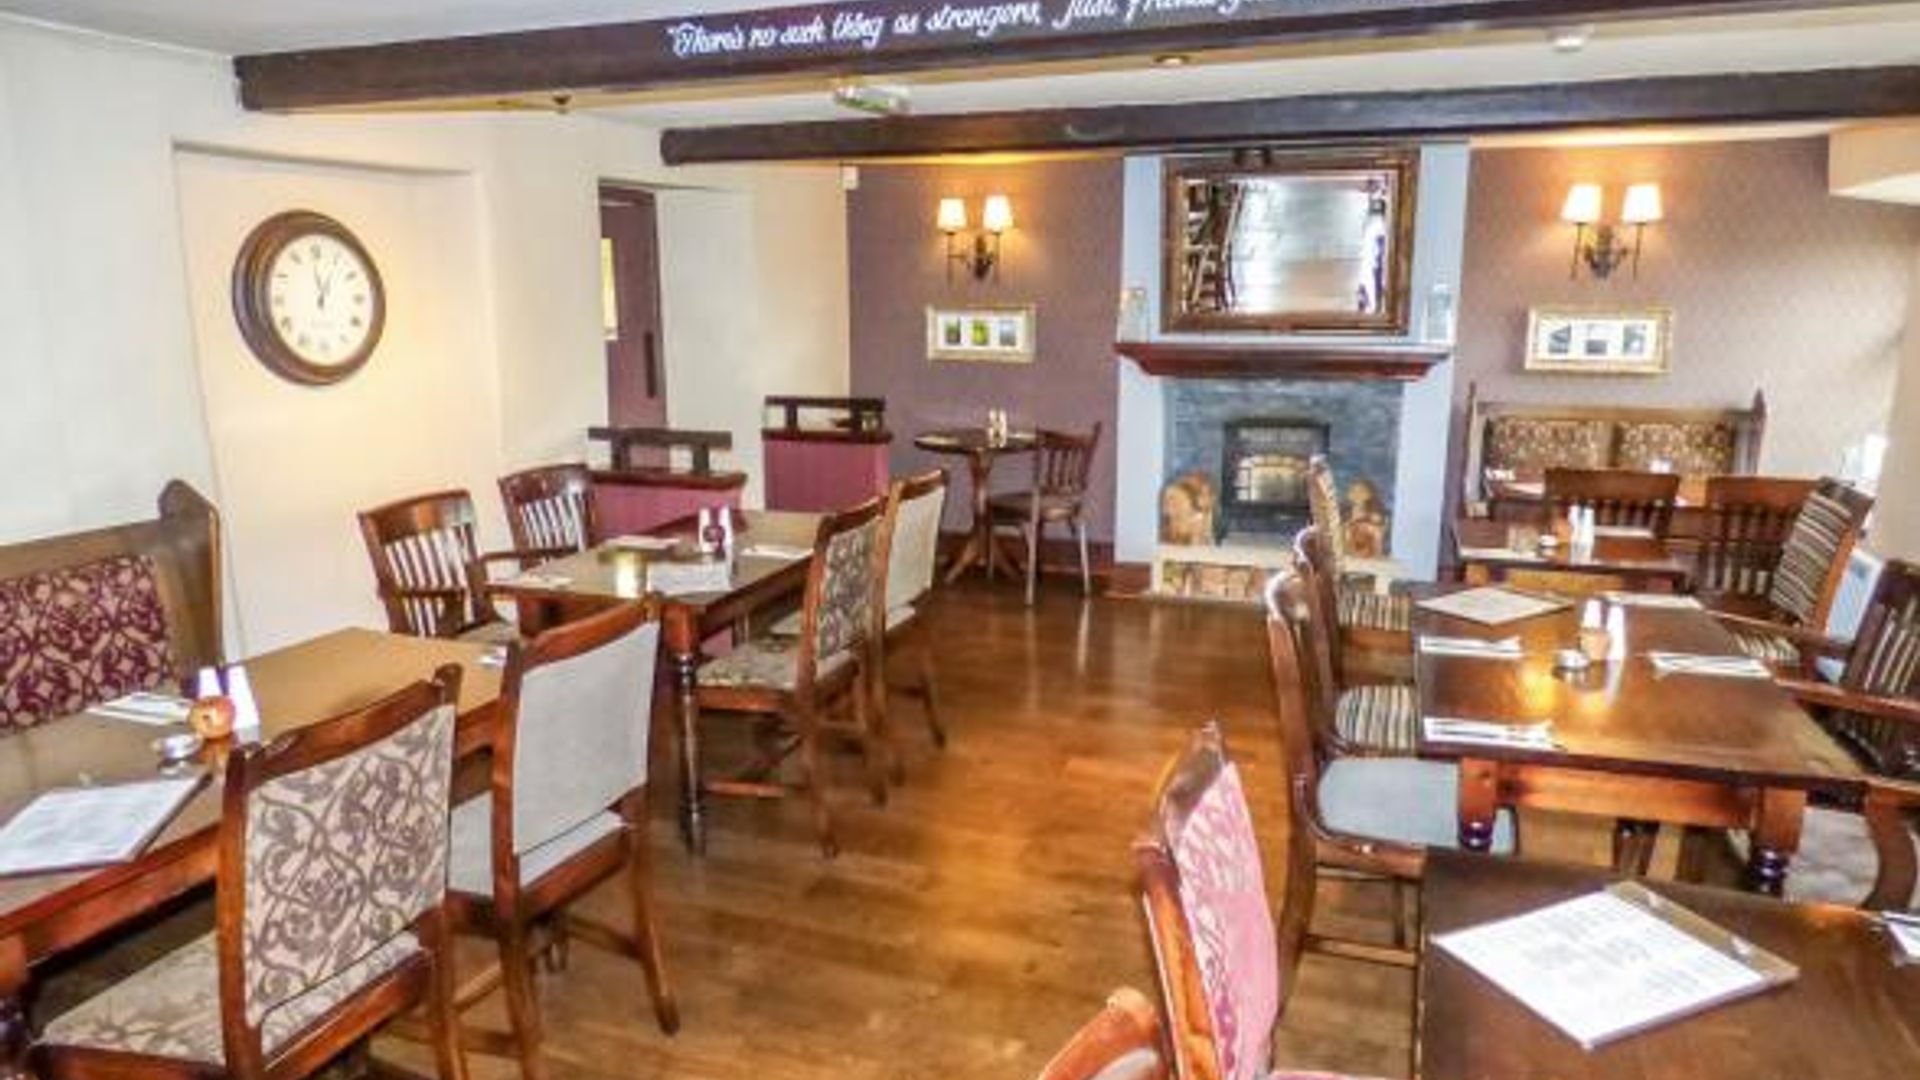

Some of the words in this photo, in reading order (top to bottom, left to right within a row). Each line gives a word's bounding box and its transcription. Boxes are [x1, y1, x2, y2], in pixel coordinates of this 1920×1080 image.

[749, 26, 776, 48] no
[780, 14, 824, 43] such
[832, 12, 883, 49] thing
[893, 13, 919, 34] as
